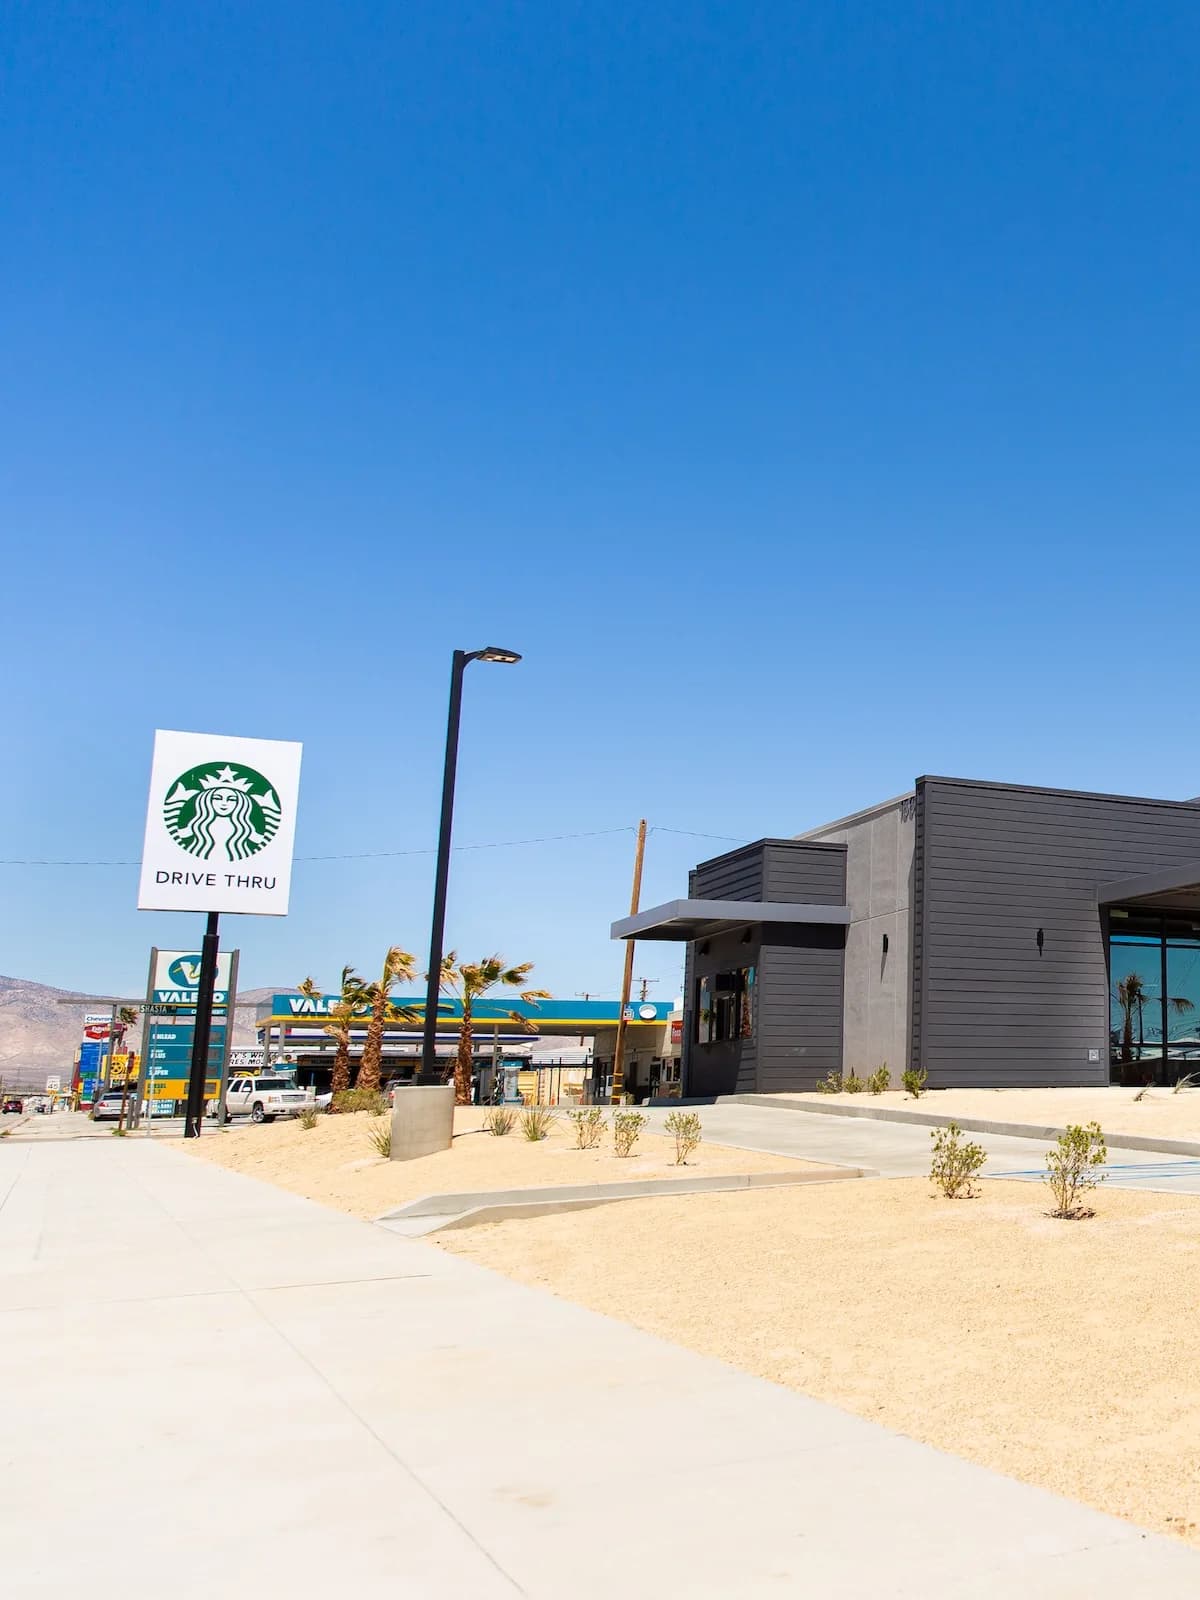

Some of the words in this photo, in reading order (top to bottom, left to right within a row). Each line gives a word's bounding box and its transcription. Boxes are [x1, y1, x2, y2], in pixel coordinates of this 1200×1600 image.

[155, 871, 217, 886] DRIVE
[224, 874, 277, 890] THRU
[158, 991, 225, 1003] VALEO
[140, 1004, 168, 1014] SHASTA
